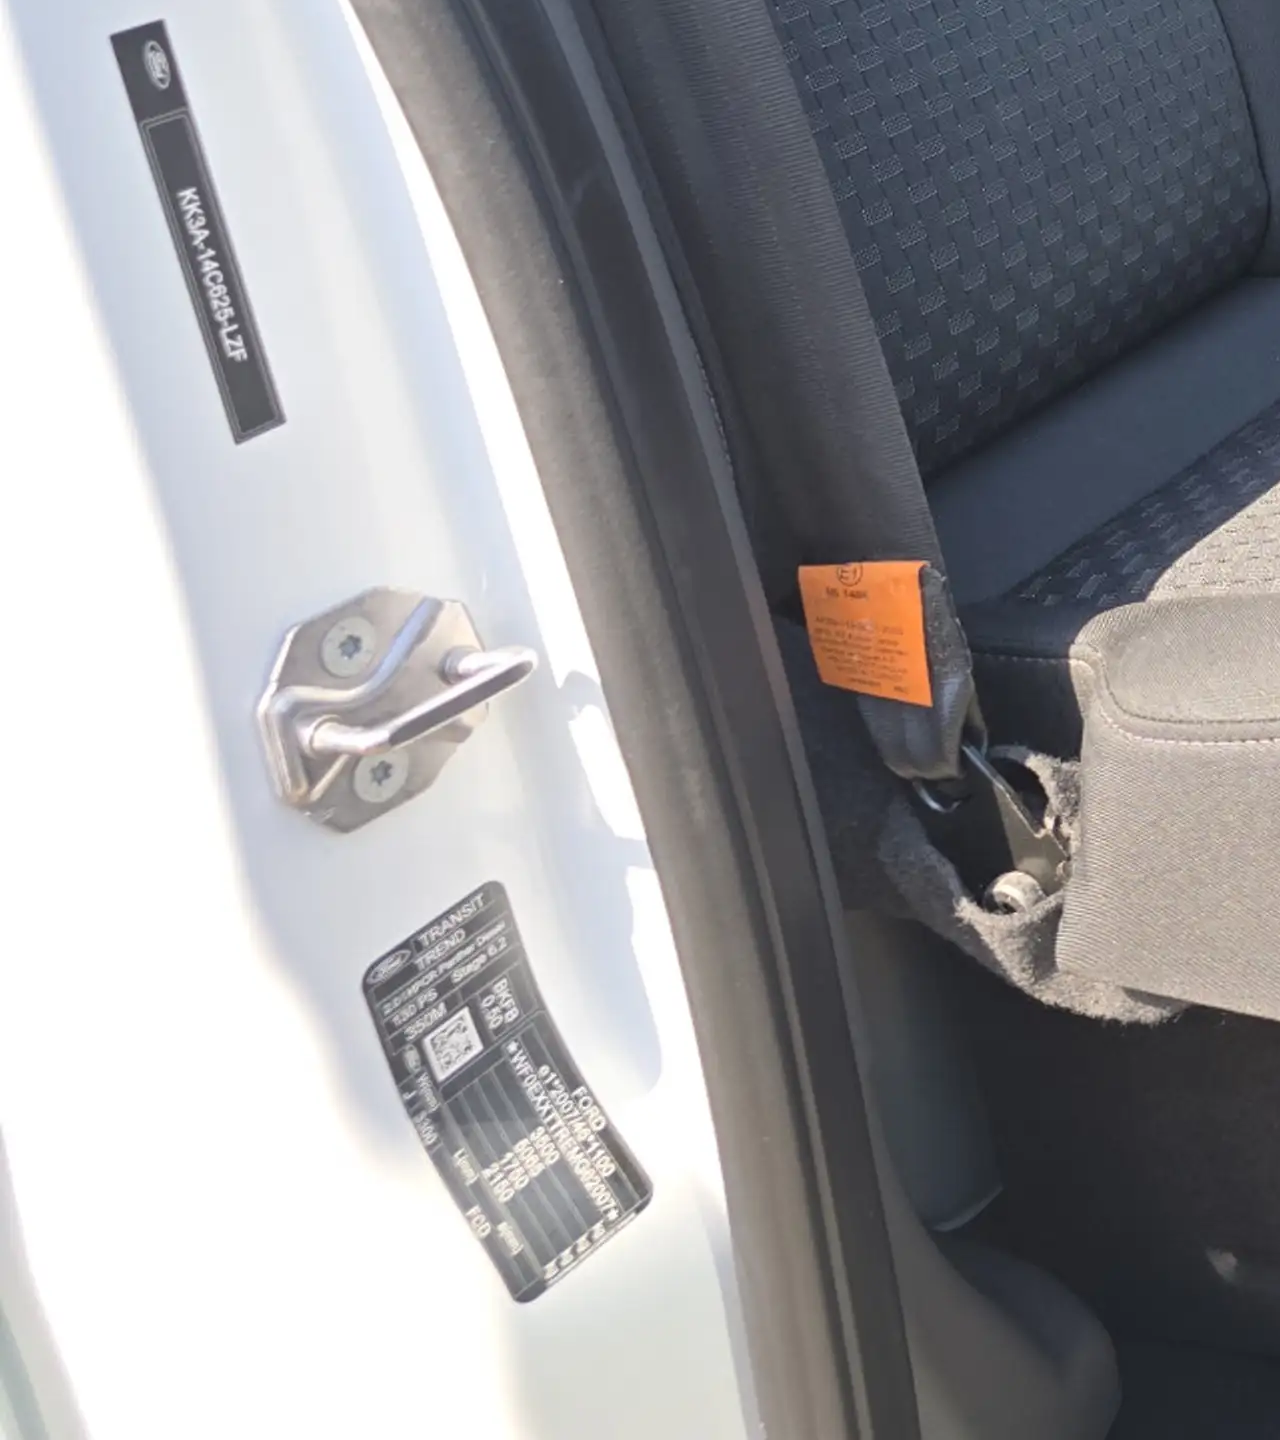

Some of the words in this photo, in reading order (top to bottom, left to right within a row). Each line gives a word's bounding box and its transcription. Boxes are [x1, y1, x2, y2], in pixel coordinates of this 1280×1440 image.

[176, 187, 248, 363] KK3A-14C625-LZF
[418, 892, 485, 947] TRANSIT
[414, 928, 466, 971] TREND
[403, 1002, 447, 1042] 350M
[493, 978, 519, 1023] BKFB
[571, 1086, 606, 1132] FORD
